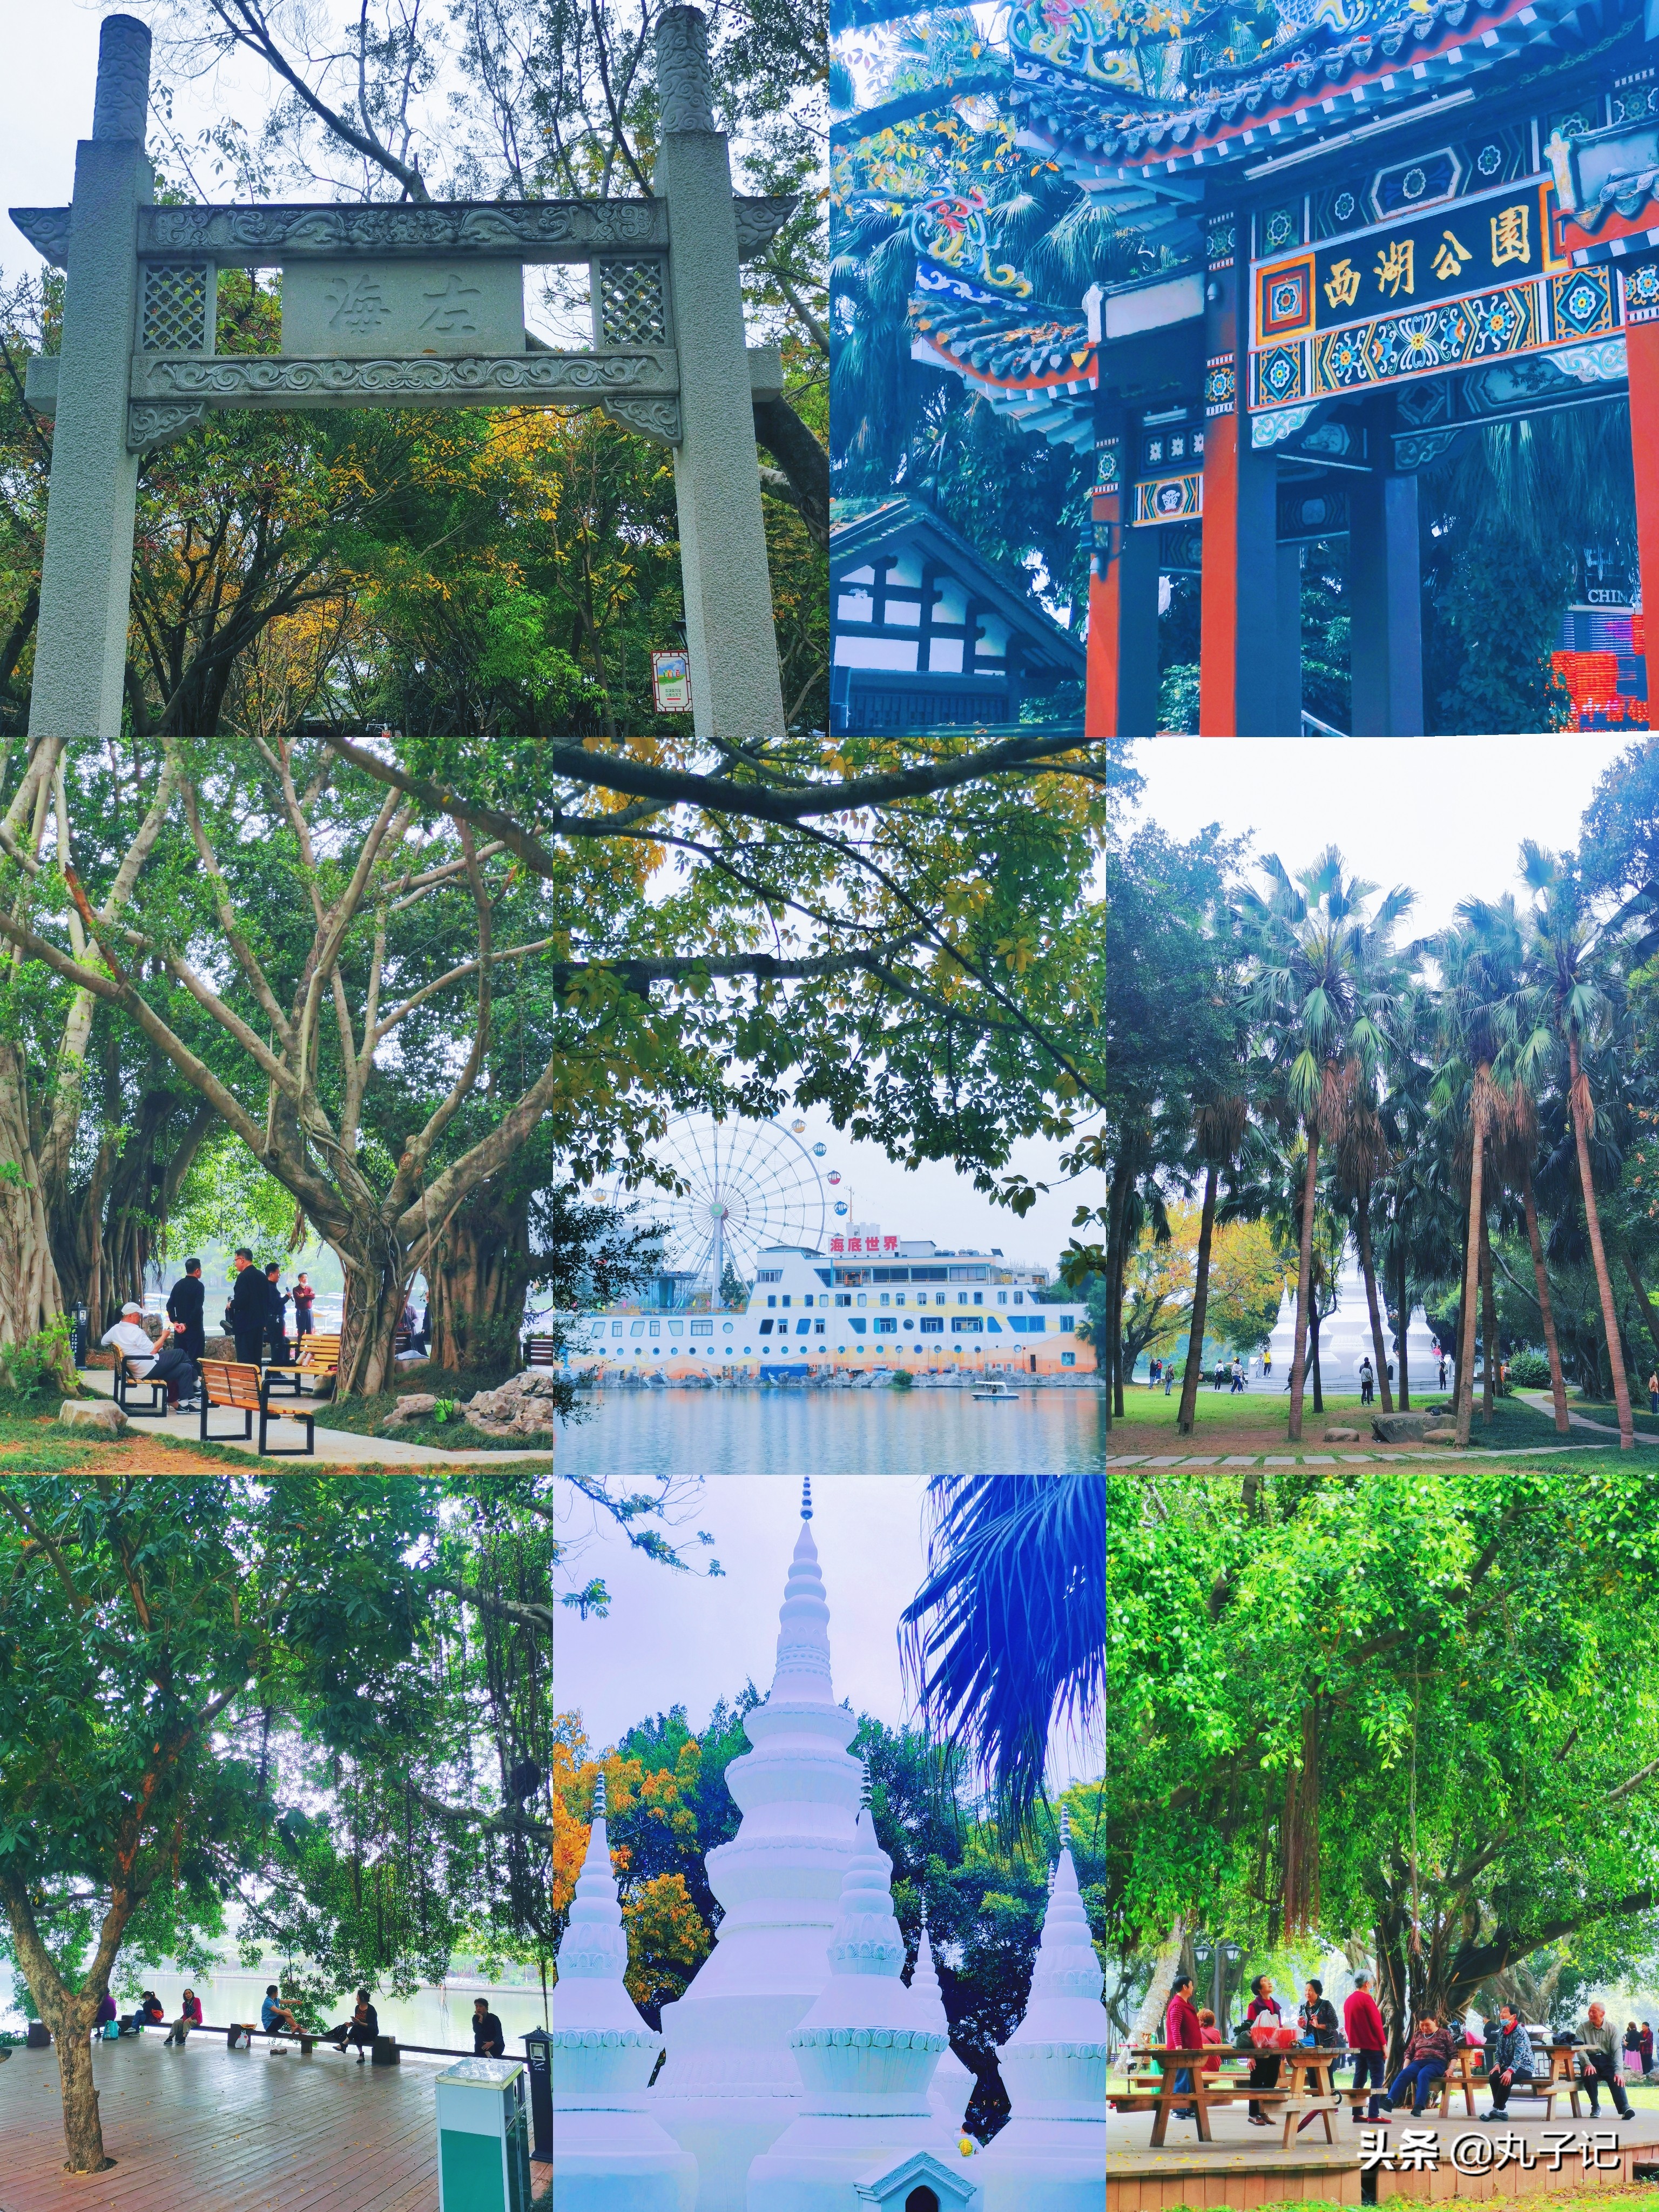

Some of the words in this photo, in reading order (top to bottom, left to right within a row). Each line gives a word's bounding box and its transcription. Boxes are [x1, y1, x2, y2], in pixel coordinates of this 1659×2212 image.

[1324, 205, 1532, 308] 西湖公園
[830, 1236, 898, 1252] 海底世界
